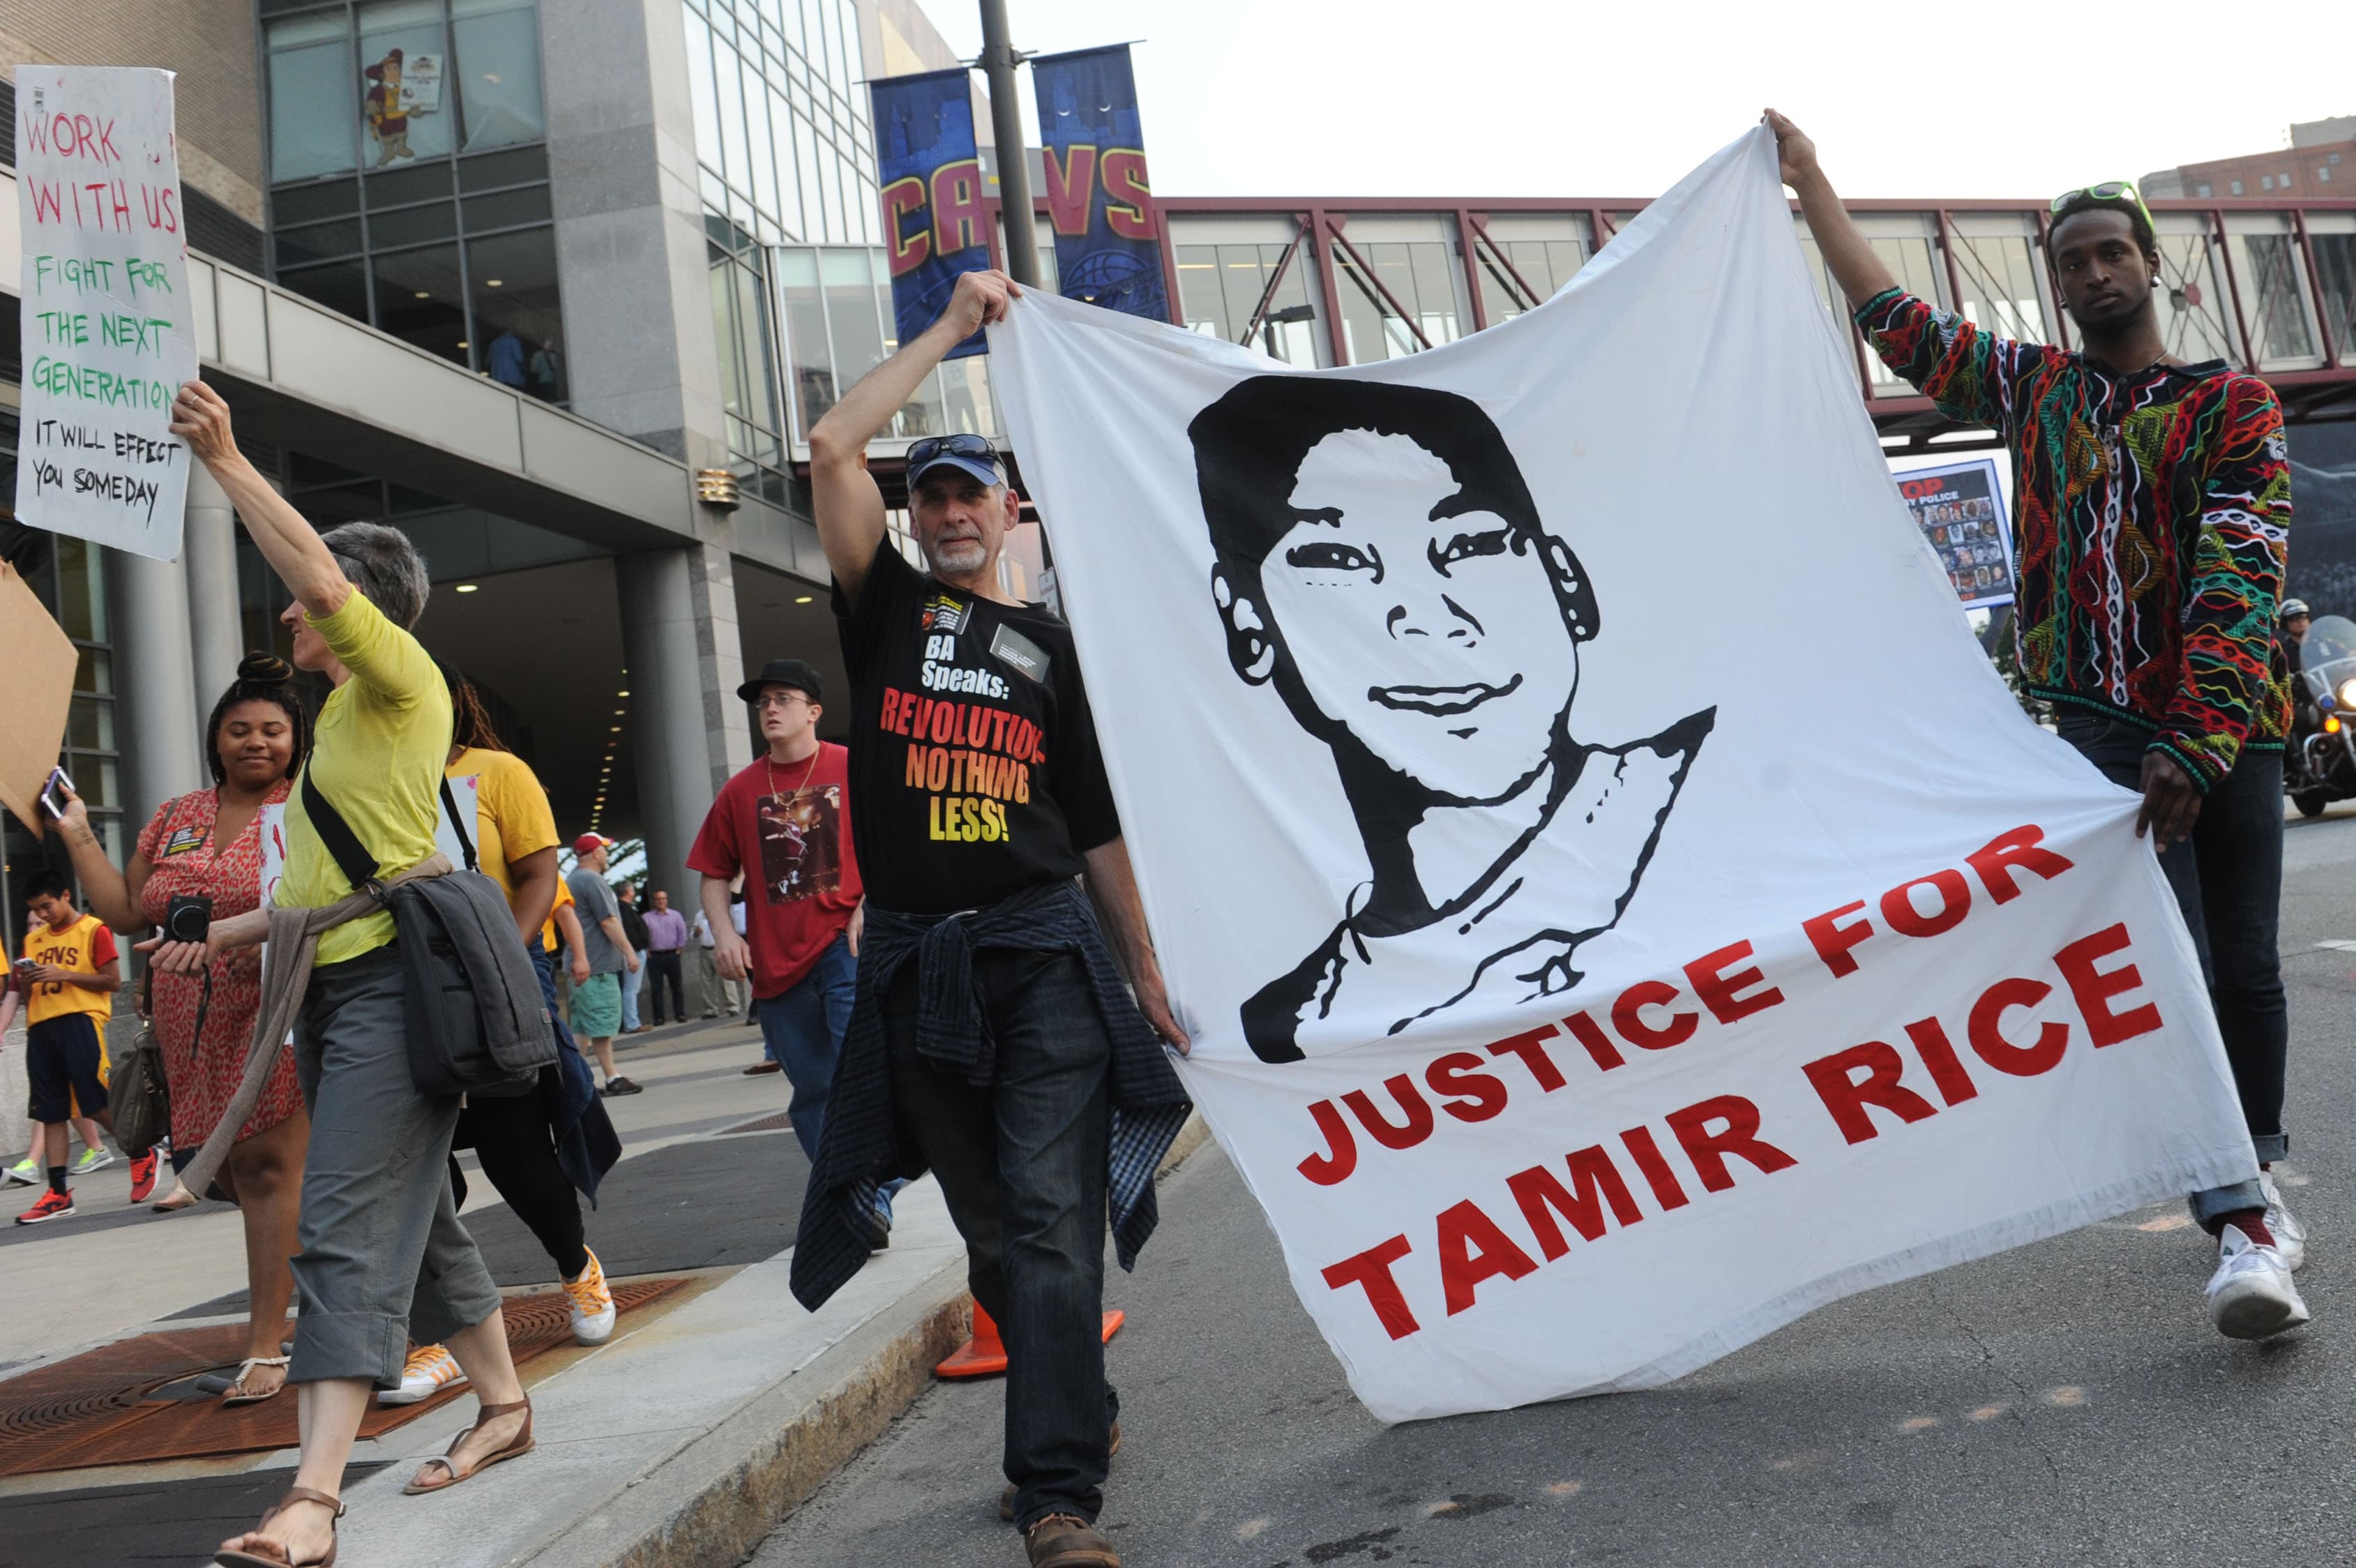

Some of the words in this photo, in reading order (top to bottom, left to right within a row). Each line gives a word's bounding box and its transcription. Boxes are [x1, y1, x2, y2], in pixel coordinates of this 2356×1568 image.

[24, 112, 120, 167] WORK
[28, 175, 131, 234] WITH
[142, 182, 176, 233] US
[36, 255, 114, 296] FIGHT
[126, 255, 172, 300] FOR
[36, 312, 89, 346] THE
[100, 311, 172, 359] NEXT
[32, 355, 181, 420] GENERATION
[37, 419, 57, 447] IT
[61, 423, 106, 449] WILL
[114, 432, 183, 467] EFFECT
[33, 457, 63, 497] YOU
[74, 468, 159, 529] SOMEDAY
[1899, 477, 1944, 499] OP
[1919, 490, 1959, 504] POLICE
[924, 634, 955, 662] BA
[921, 660, 1010, 700] Speaks:
[905, 743, 1029, 805] NOTHING
[929, 796, 1009, 843] LESS!
[36, 945, 79, 966] CAVS
[1297, 940, 1784, 1186] JUSTICE
[1803, 824, 2074, 977] FOR
[1321, 1095, 1798, 1341] TAMIR
[1803, 923, 2163, 1145] RICE
